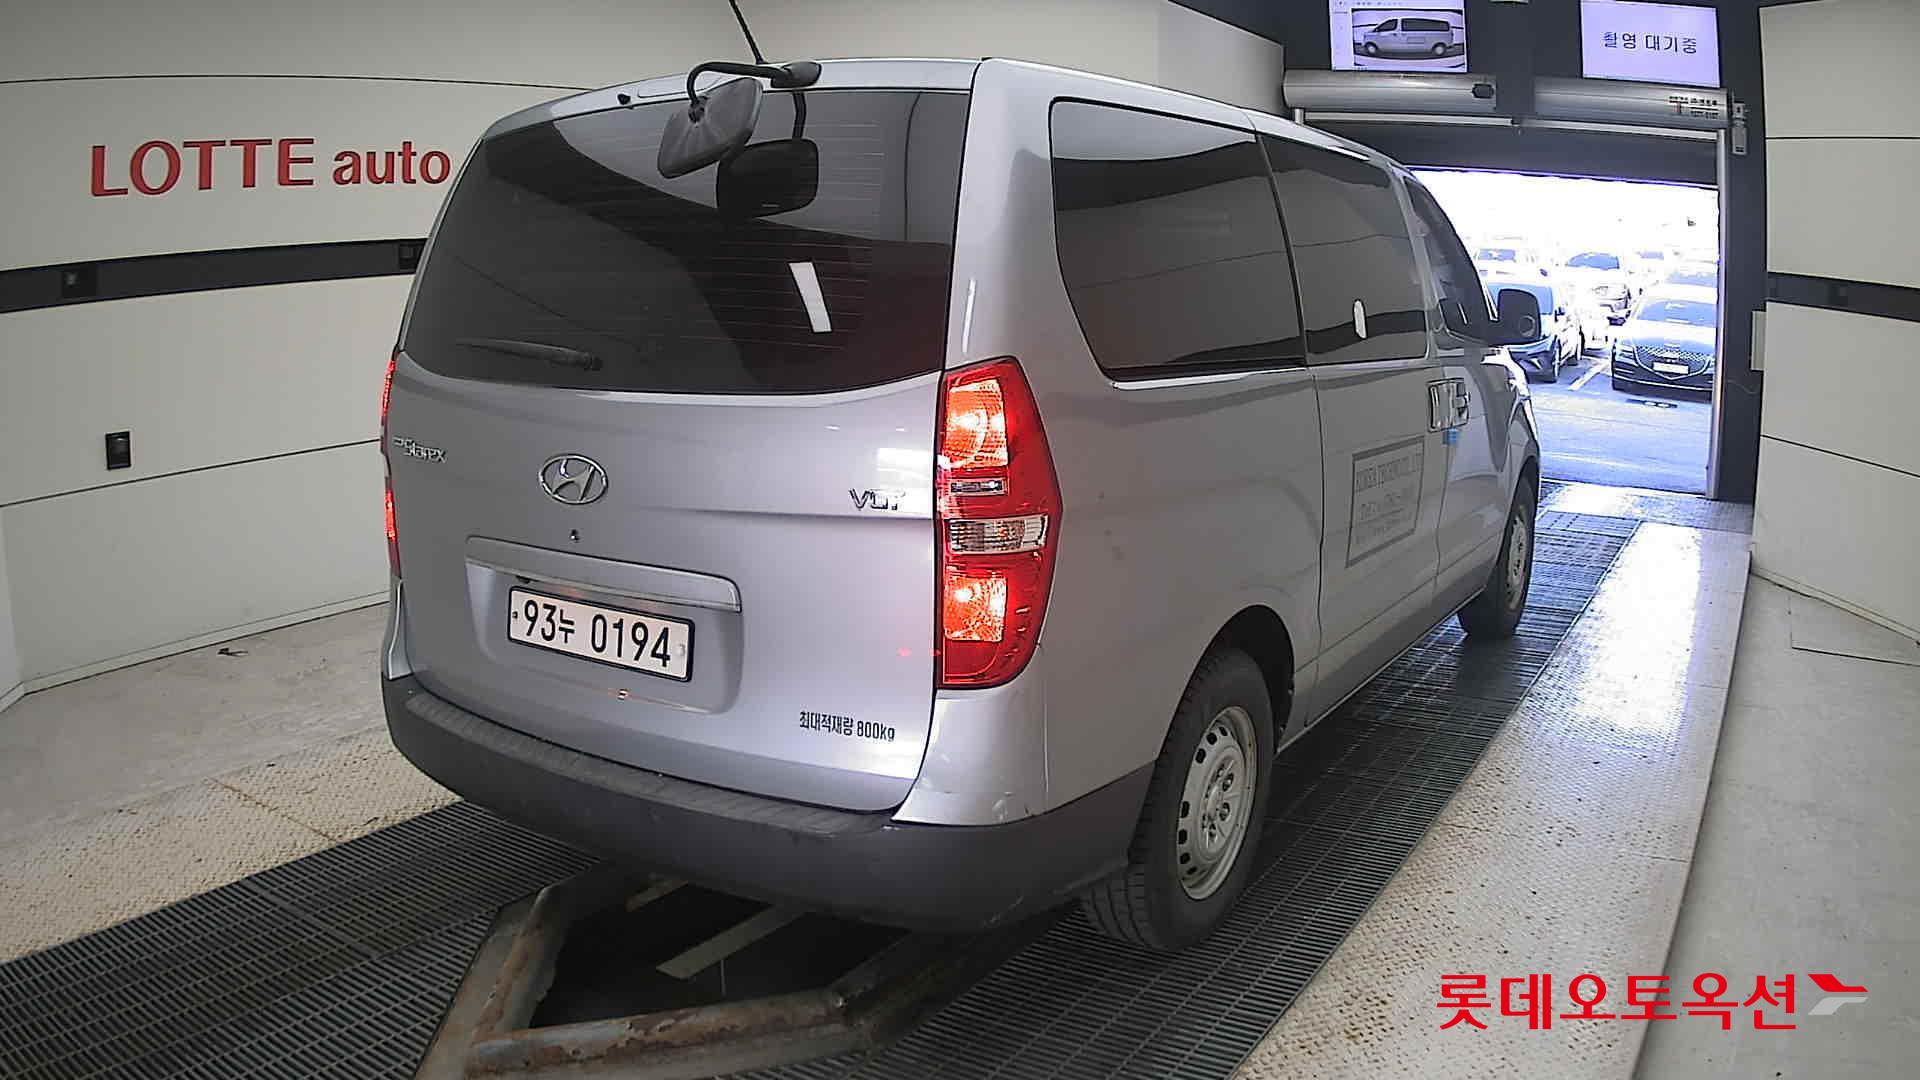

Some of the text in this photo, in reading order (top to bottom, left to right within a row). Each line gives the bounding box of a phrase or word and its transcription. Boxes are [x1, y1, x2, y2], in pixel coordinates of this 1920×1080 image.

[1645, 34, 1697, 54] 대기중
[91, 137, 451, 198] LOTTE auto
[524, 599, 671, 668] 93누 0194
[799, 710, 896, 742] 최대적재량 800kg
